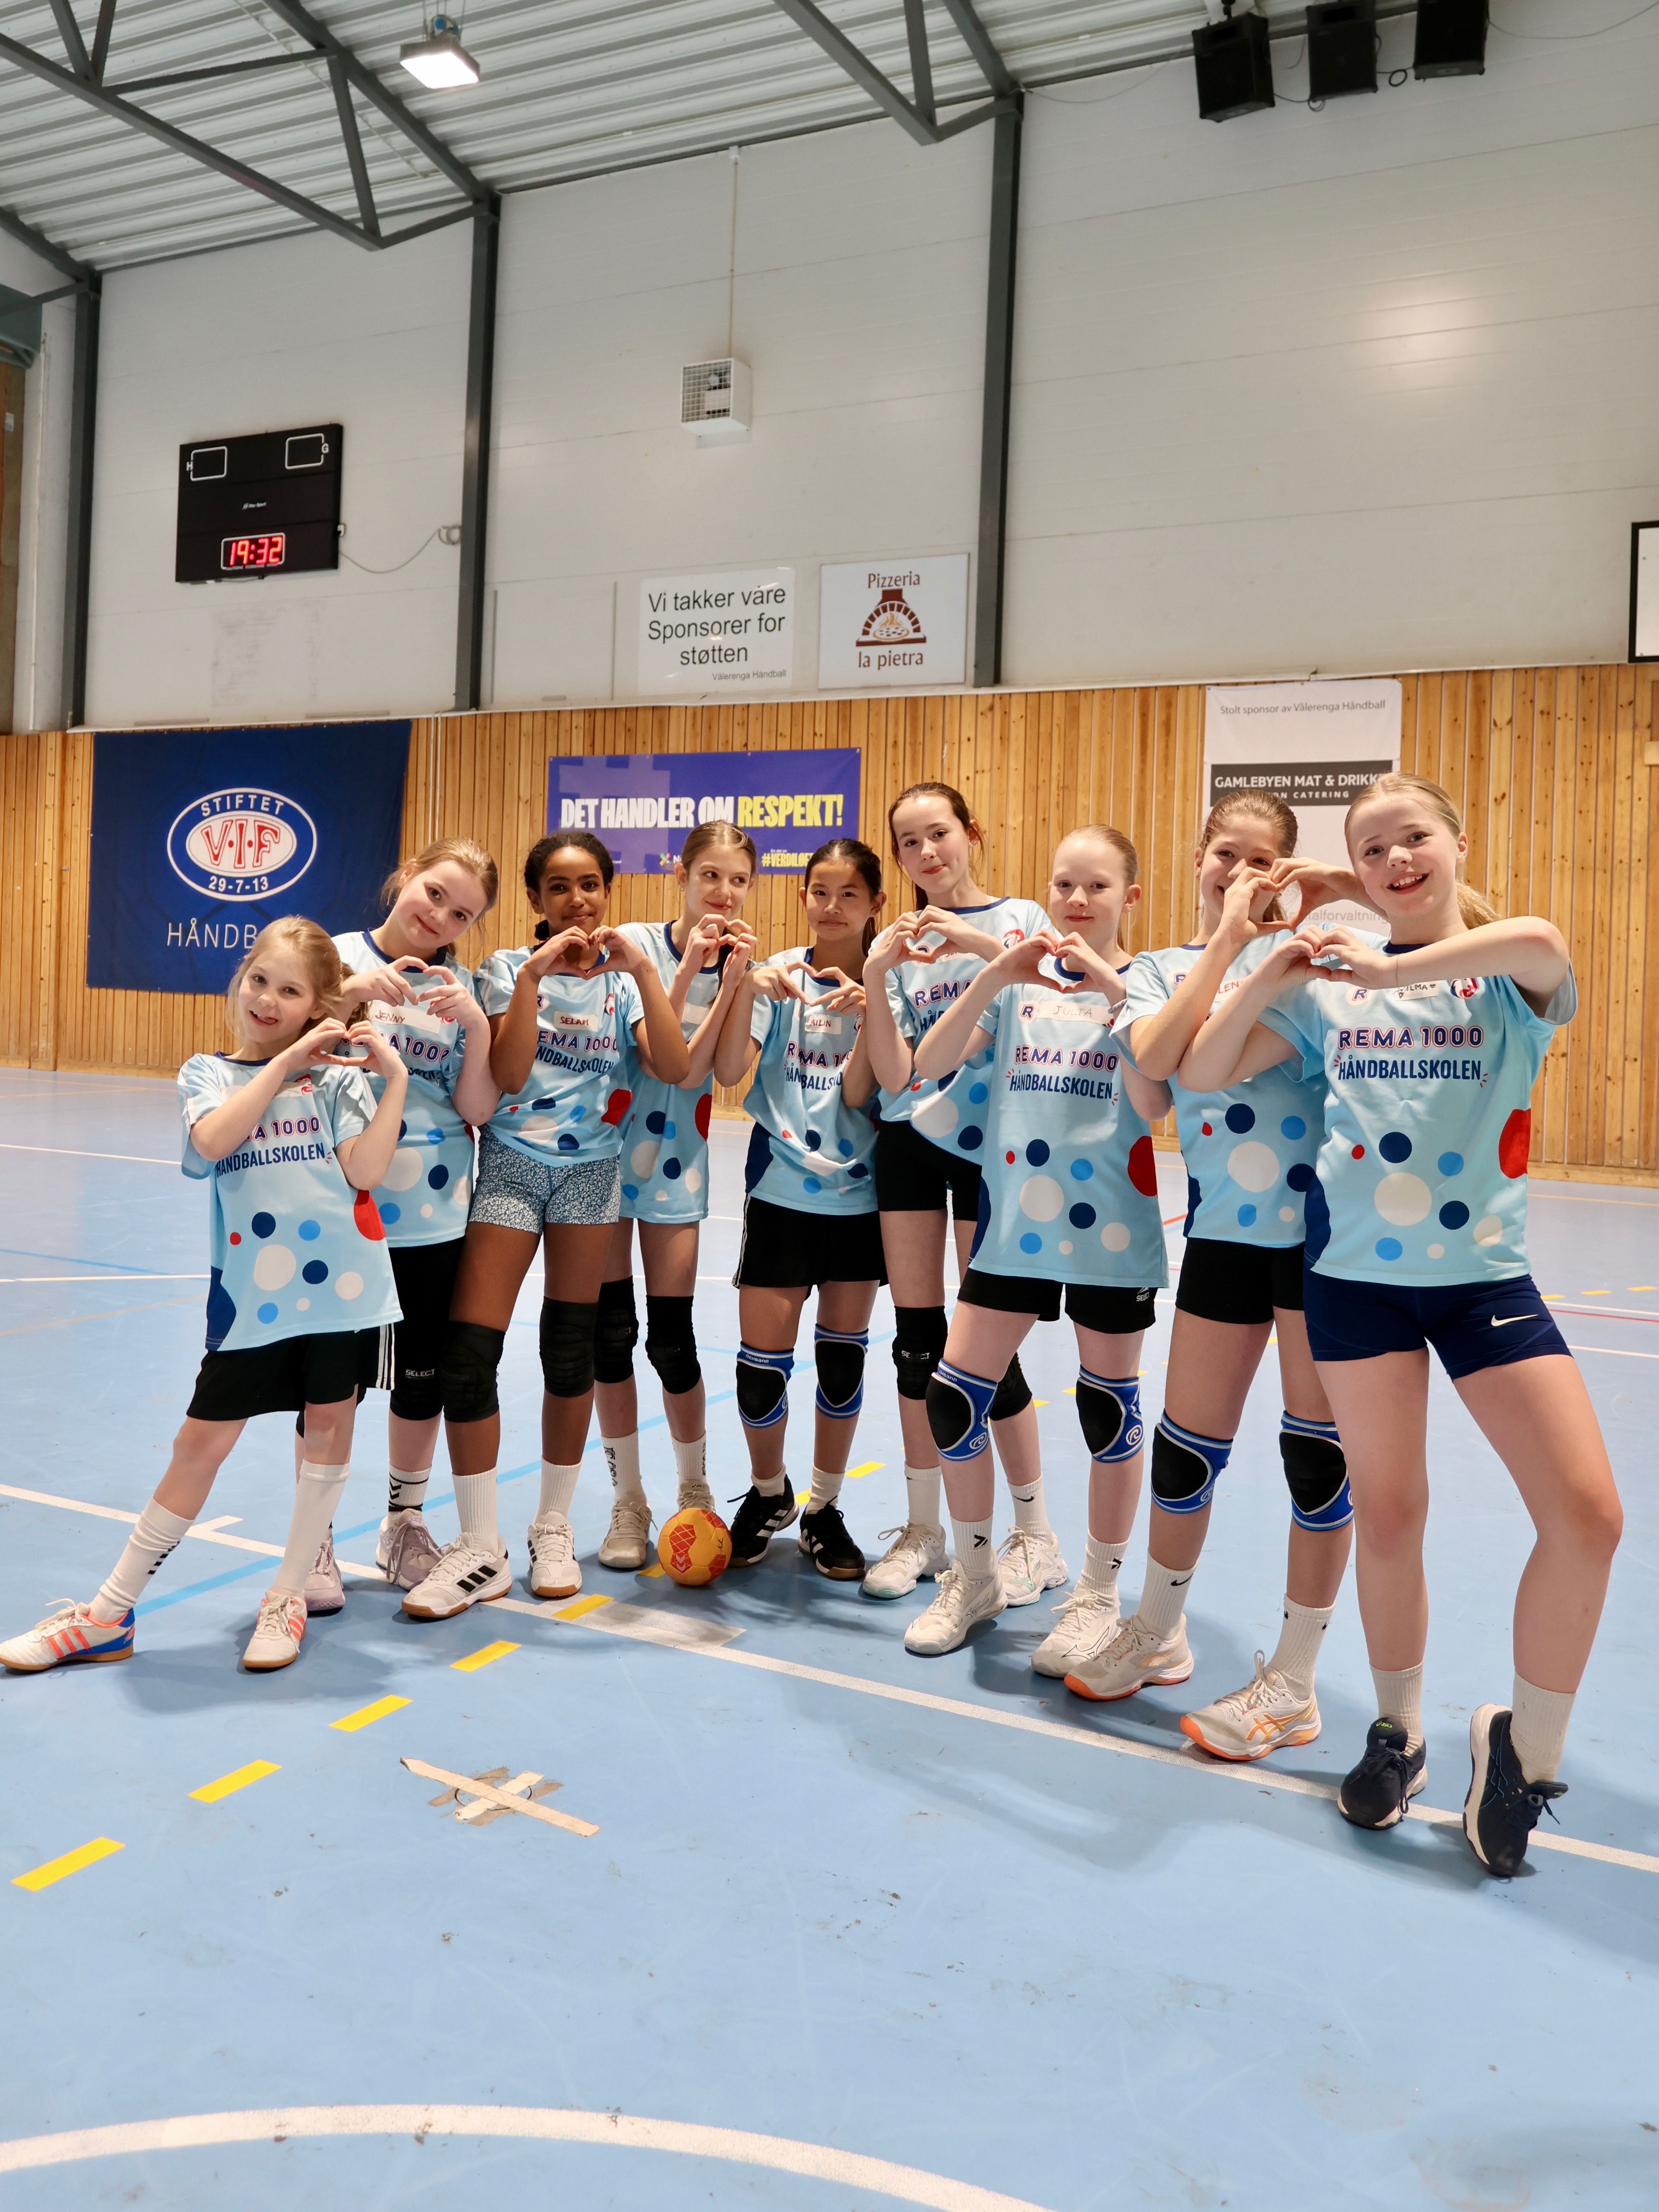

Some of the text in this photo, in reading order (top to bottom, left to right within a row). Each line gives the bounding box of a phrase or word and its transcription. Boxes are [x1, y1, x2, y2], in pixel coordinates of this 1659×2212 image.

[321, 444, 329, 454] G
[186, 461, 193, 471] H
[229, 536, 283, 567] 19:32
[868, 571, 920, 588] Pizzeria
[648, 592, 666, 612] Vi
[673, 589, 734, 610] takker
[648, 612, 785, 643] Sponsorer for
[680, 644, 748, 665] støtten
[858, 650, 923, 670] la pietra
[1220, 706, 1240, 714] Stolt
[1243, 706, 1279, 715] sponsor
[1294, 702, 1339, 712] Vålerenga
[1342, 700, 1386, 710] Håndball
[1215, 773, 1382, 788] GAMLEBYEN MAT & DRIKK
[200, 794, 285, 817] STIFTET
[561, 794, 844, 829] DET HANDLER OM RESPEKT!
[208, 876, 269, 893] 29-7-13
[167, 917, 257, 948] HÅNDB
[1352, 988, 1369, 1001] R
[375, 1010, 405, 1023] JENNY
[1020, 1004, 1035, 1019] R
[537, 1028, 579, 1051] EMA
[1338, 1025, 1484, 1050] REMA 1000
[1014, 1044, 1119, 1073] REMA 1000
[1338, 1055, 1481, 1081] HÅNDBALLSKOLEN
[1009, 1070, 1113, 1100] HÅNDBALLSKOLEN
[271, 1115, 321, 1138] 1000
[901, 1350, 930, 1360] SECT
[405, 1368, 435, 1377] SELECT
